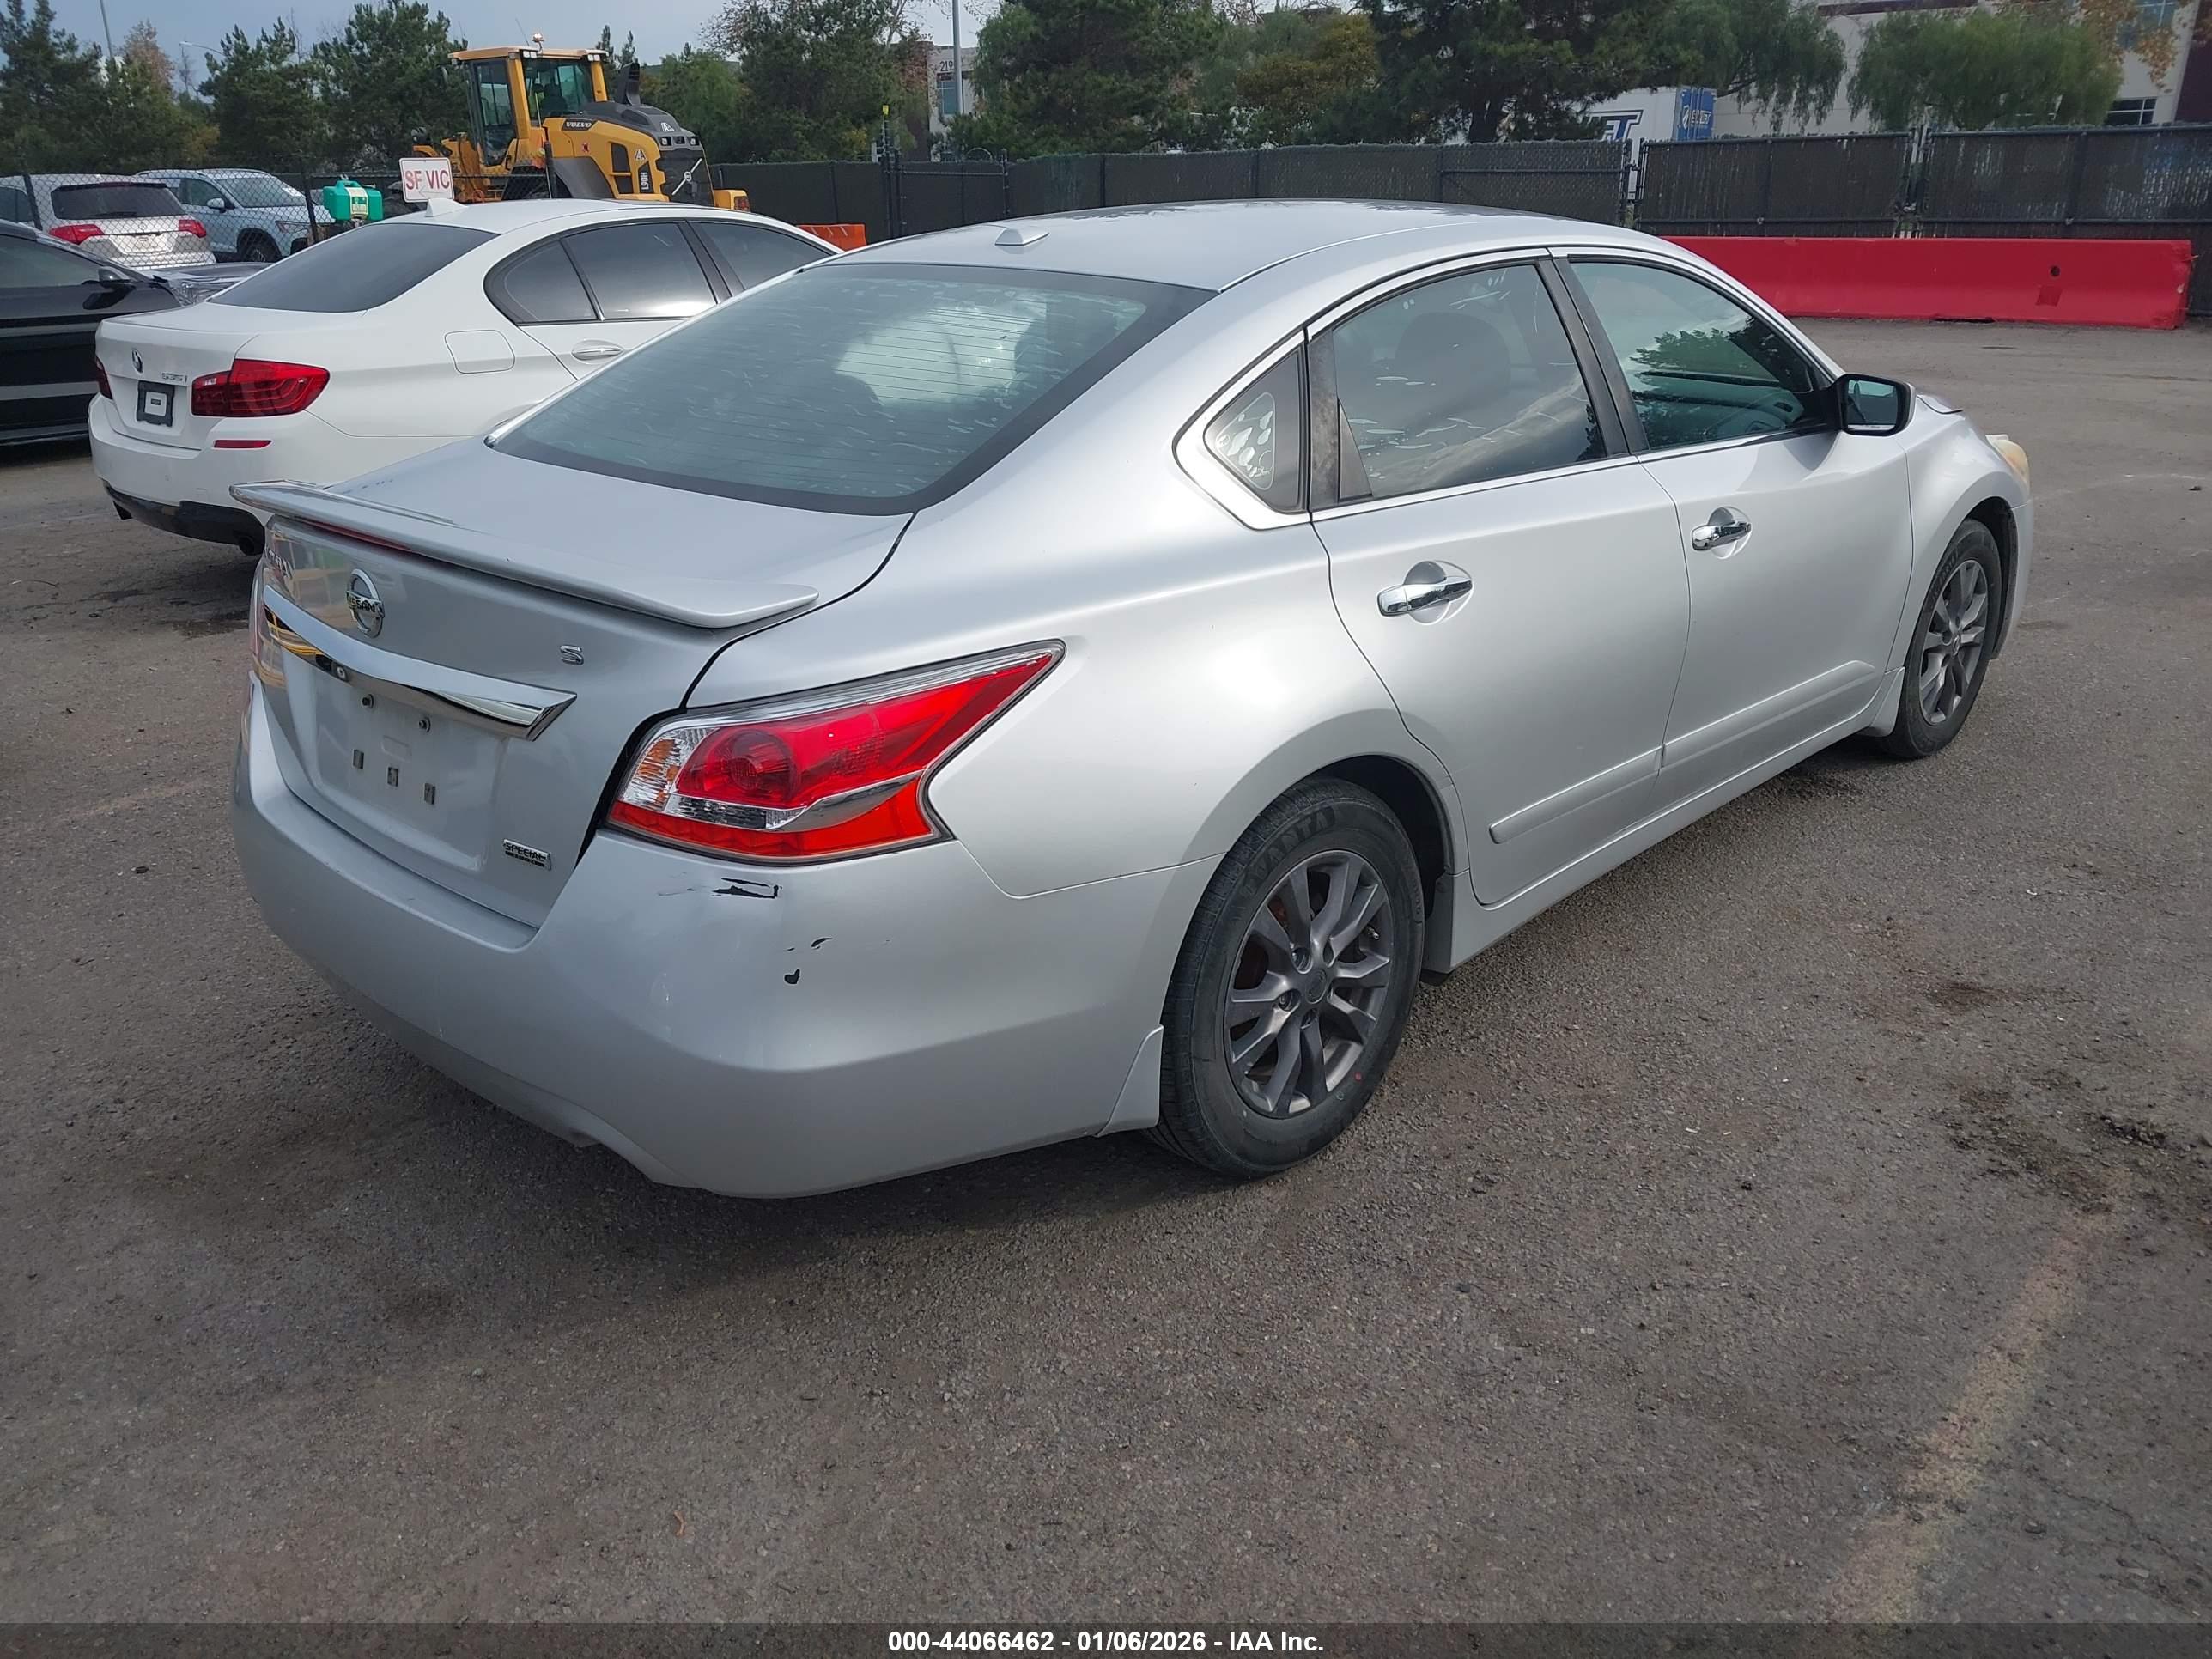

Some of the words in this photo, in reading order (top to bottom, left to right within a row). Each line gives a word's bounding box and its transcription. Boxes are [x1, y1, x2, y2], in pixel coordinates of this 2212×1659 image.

[404, 170, 422, 190] SF
[425, 170, 450, 190] VIC
[641, 172, 649, 190] L90H
[560, 645, 584, 665] S
